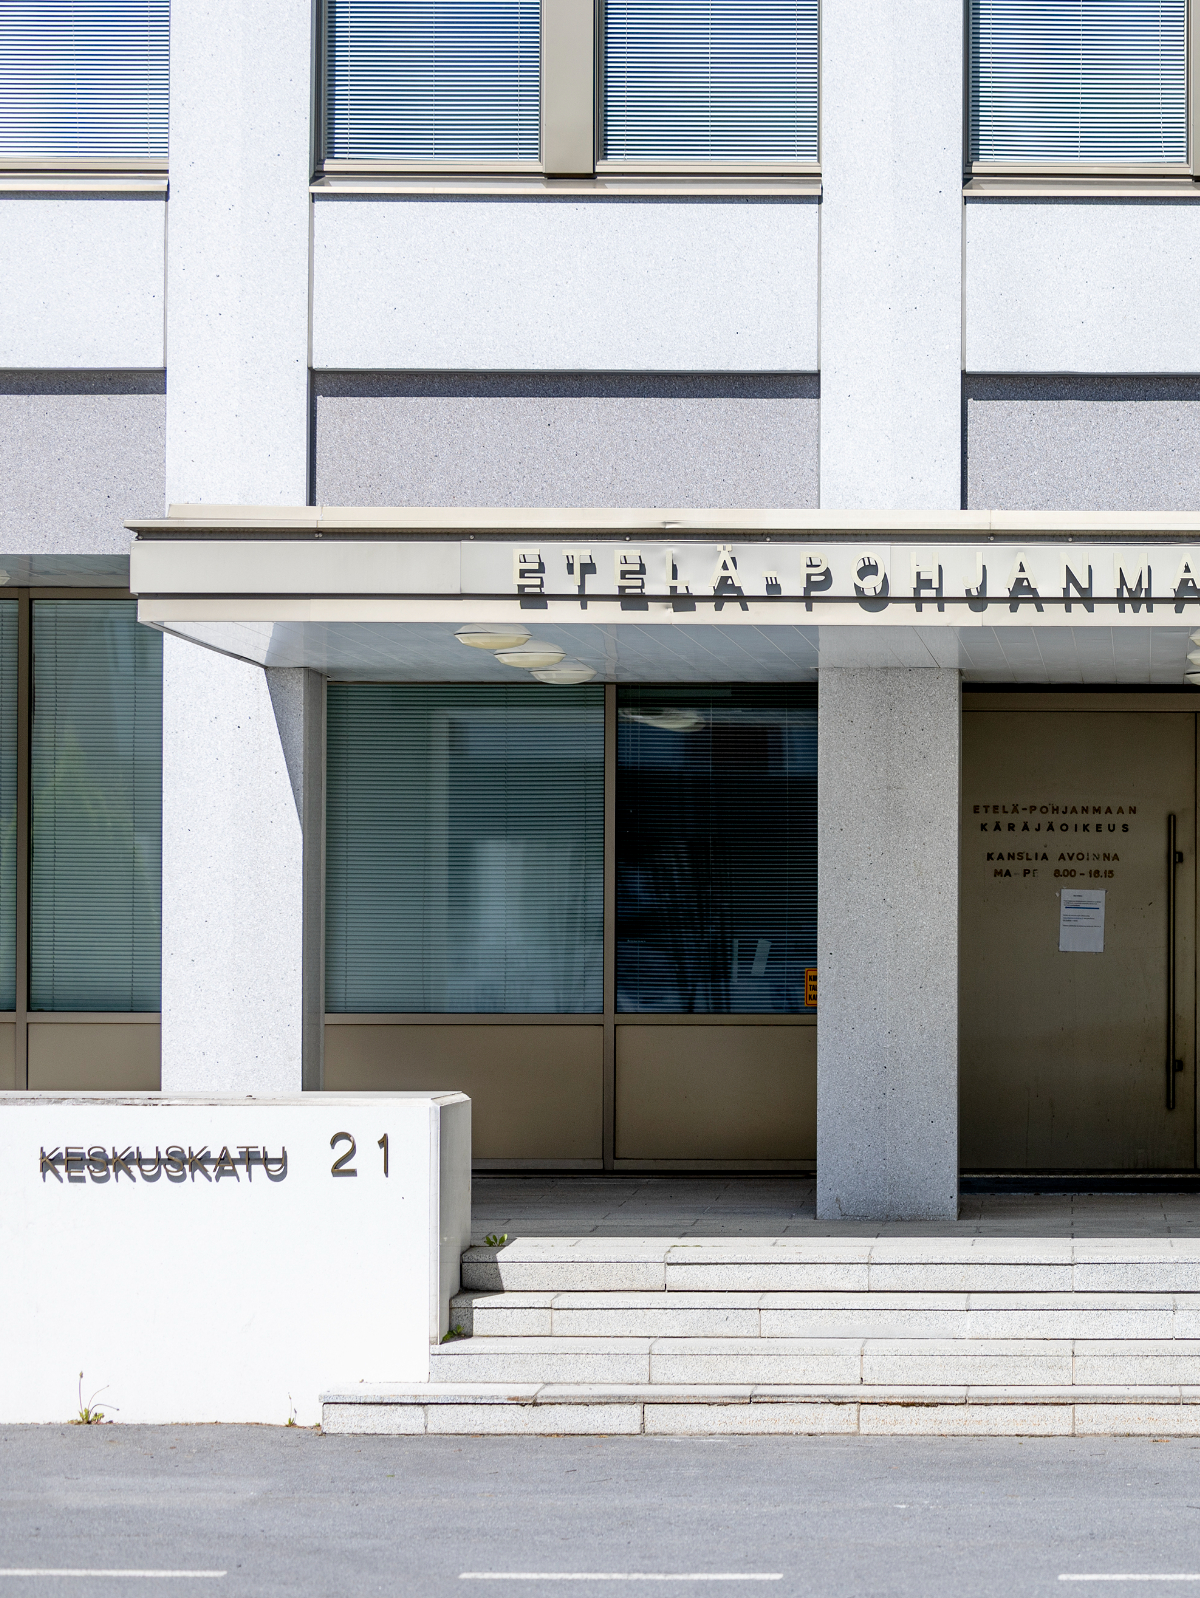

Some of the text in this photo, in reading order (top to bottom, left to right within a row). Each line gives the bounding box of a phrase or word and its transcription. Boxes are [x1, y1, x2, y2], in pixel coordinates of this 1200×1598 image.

[973, 803, 1137, 815] ETELÄ-POHJANMAAN
[980, 821, 1129, 833] KÄRÄJÄOIKEUS
[987, 852, 1120, 862] KANSLIA AVOINNA
[39, 1131, 391, 1180] KESKUSKATU 21
